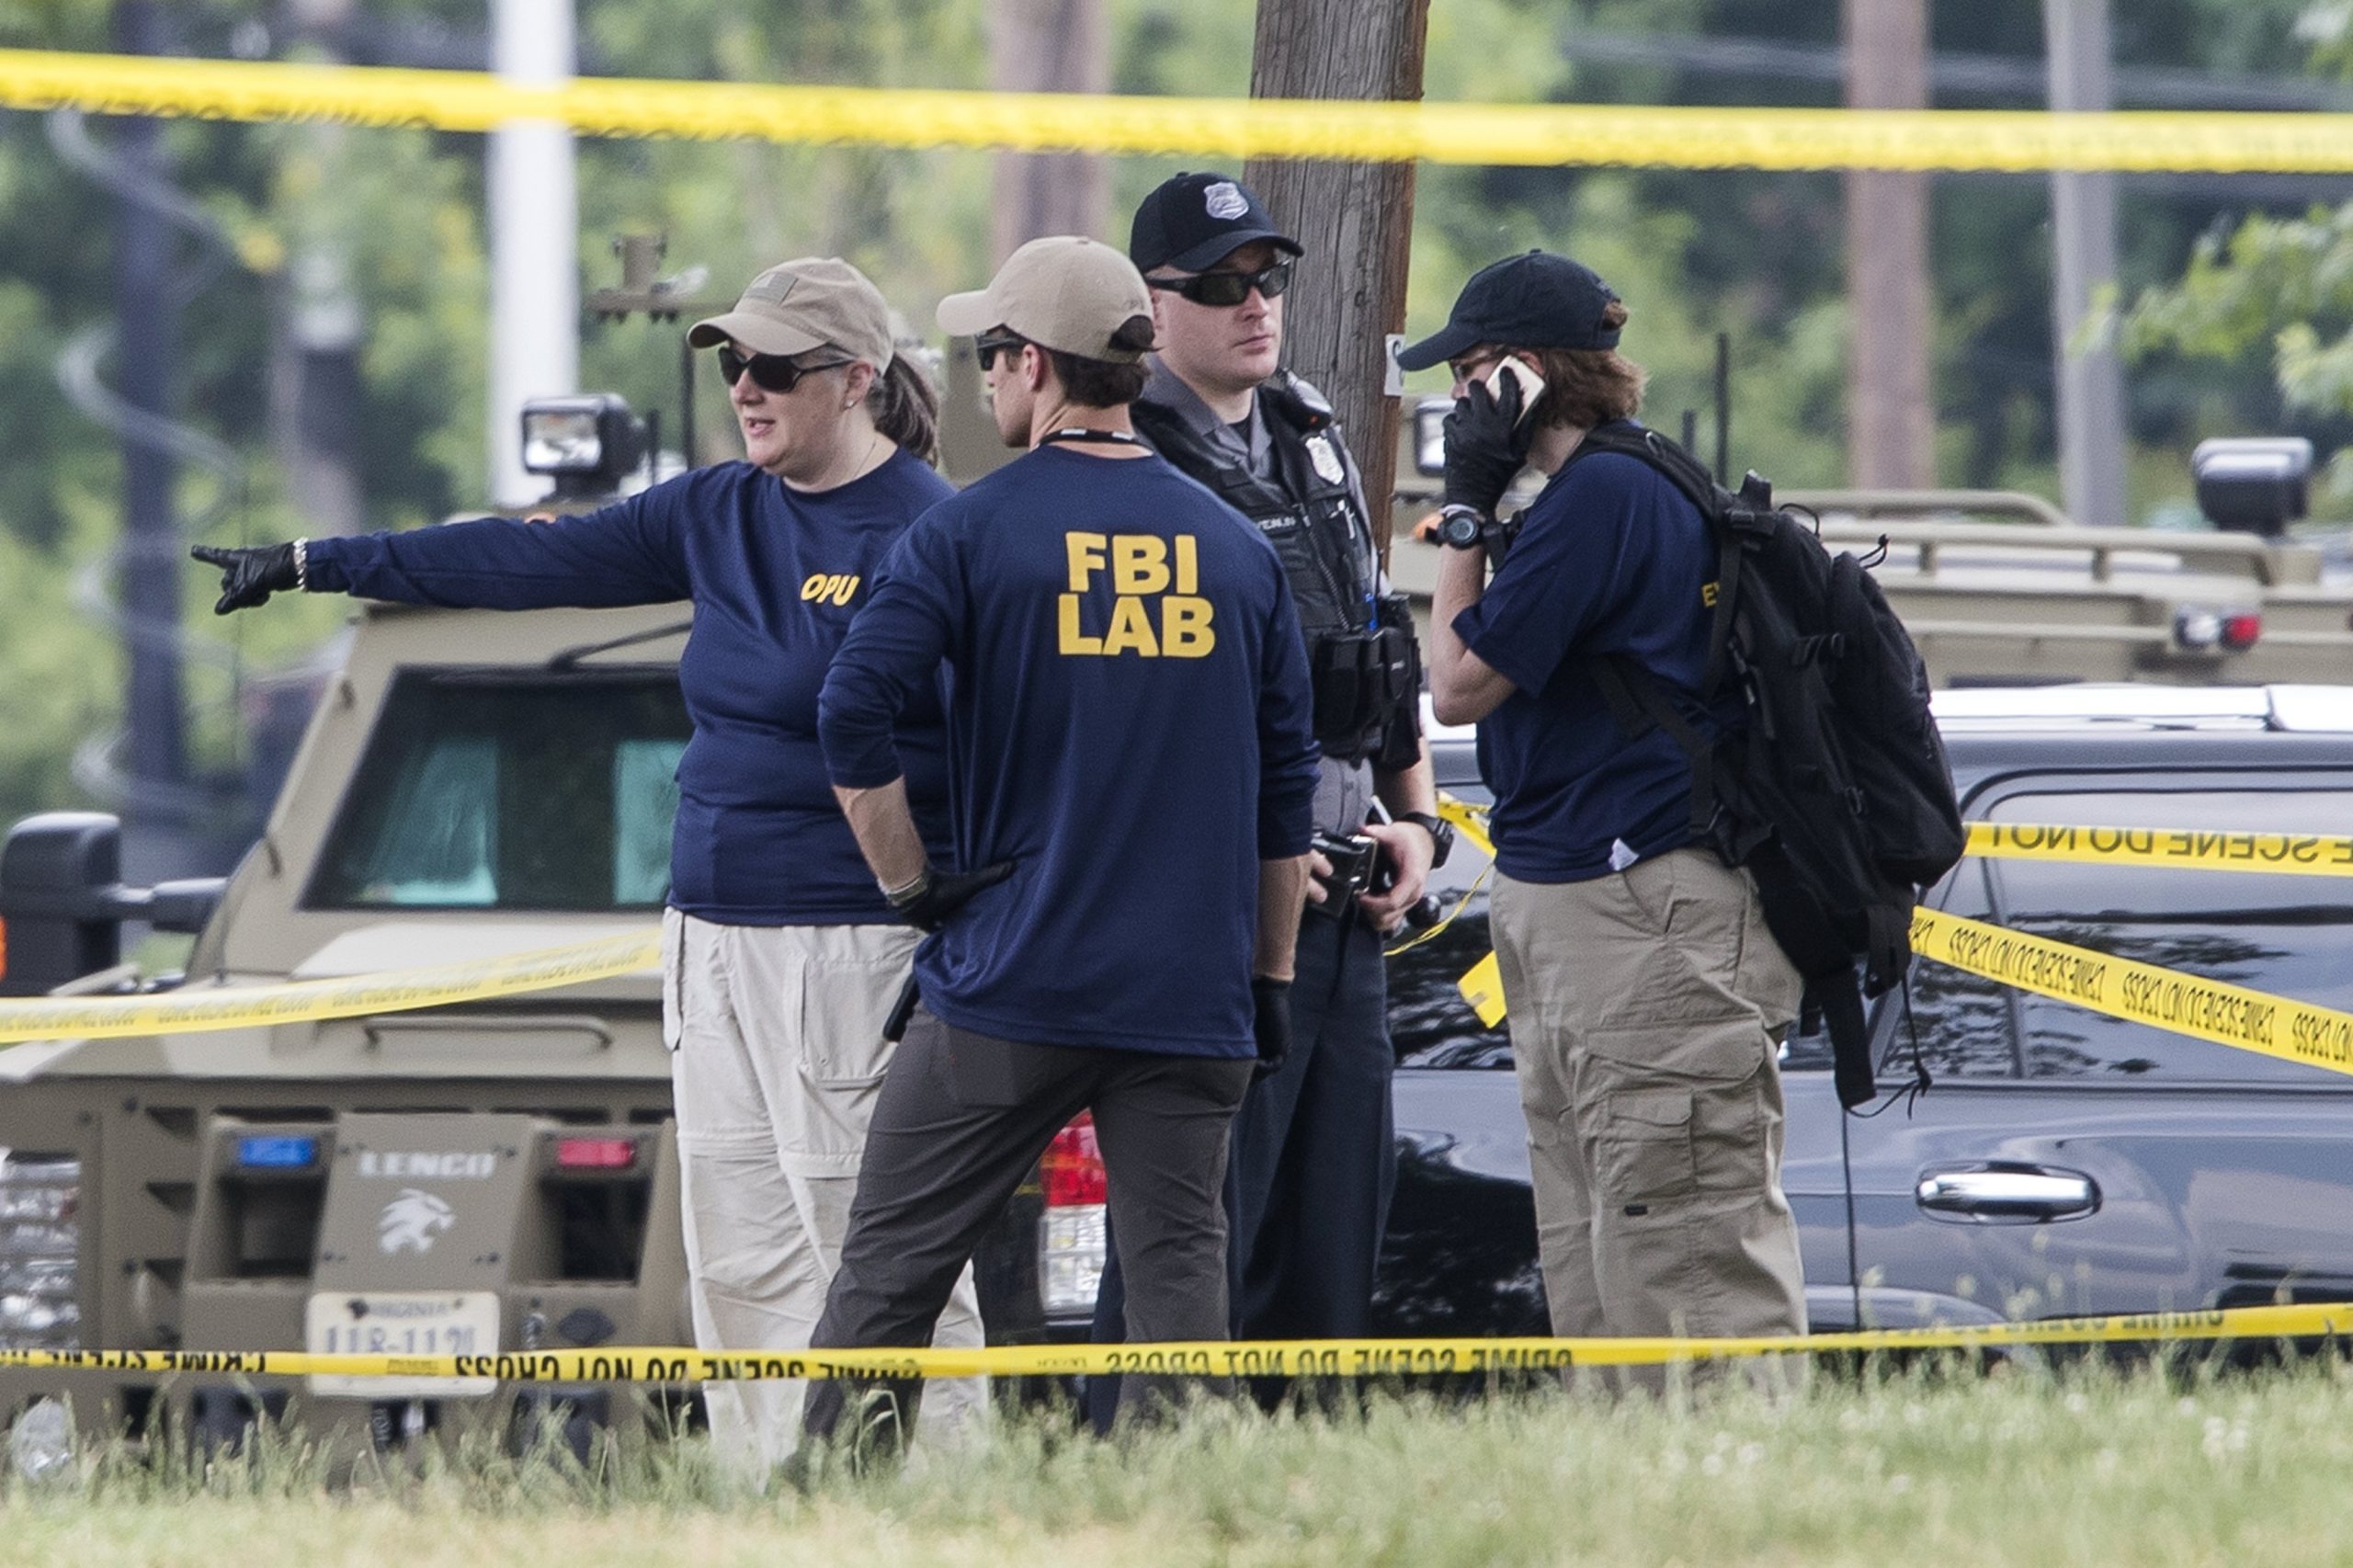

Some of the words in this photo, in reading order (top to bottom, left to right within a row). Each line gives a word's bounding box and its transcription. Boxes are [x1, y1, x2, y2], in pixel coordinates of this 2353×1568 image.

[1064, 531, 1198, 595] FBI
[801, 574, 860, 607] OPU
[1058, 593, 1216, 658] LAB
[360, 1151, 496, 1178] LENCO
